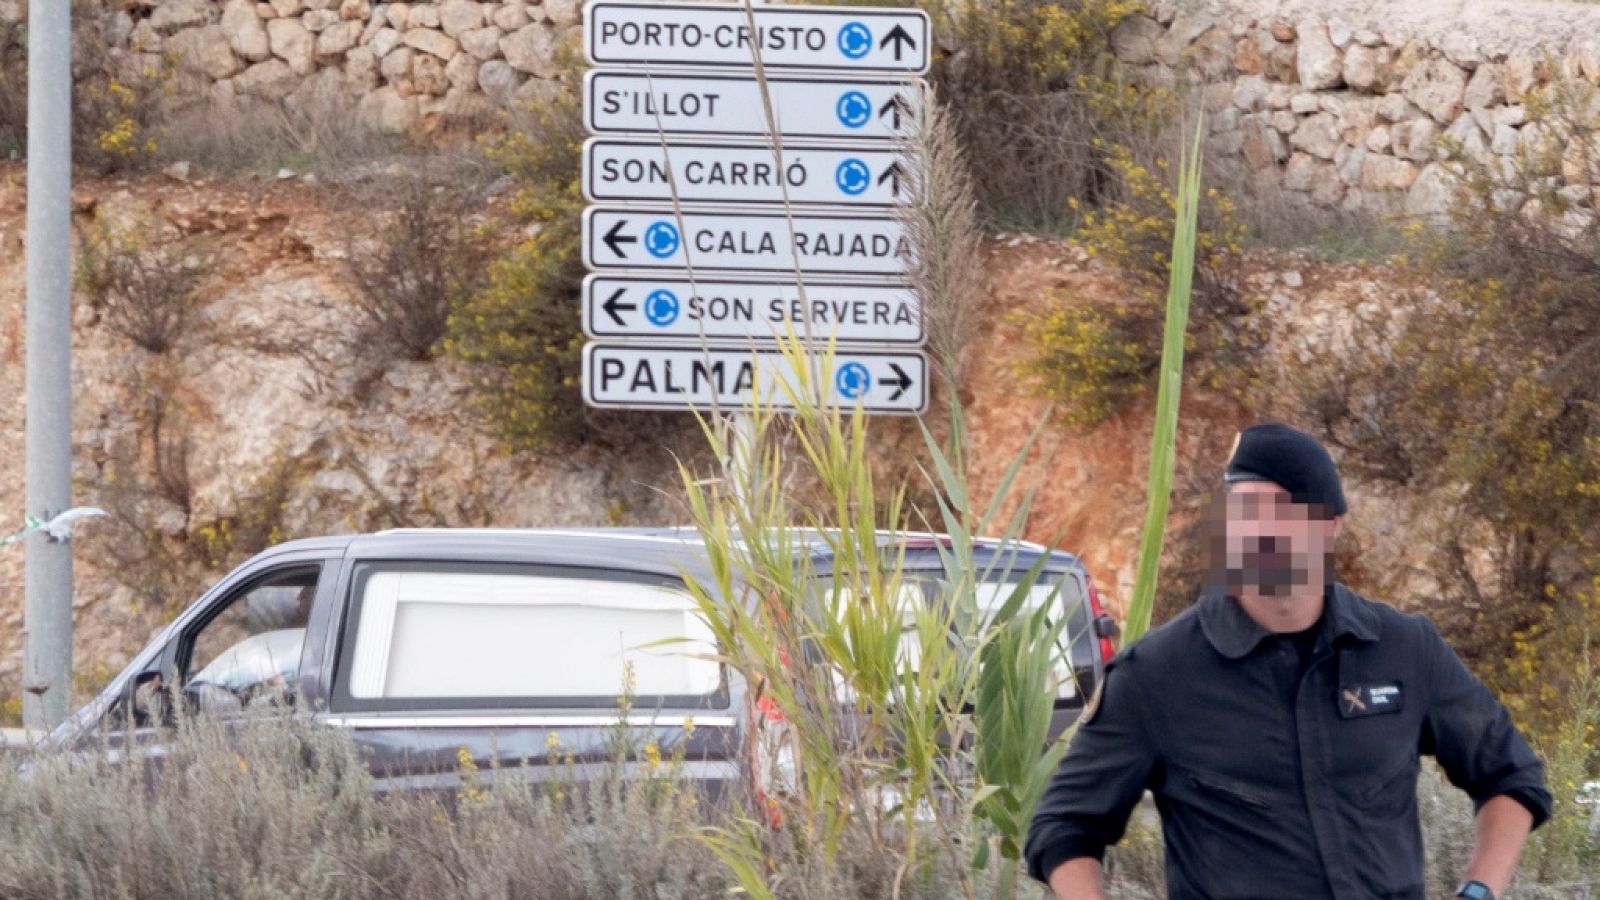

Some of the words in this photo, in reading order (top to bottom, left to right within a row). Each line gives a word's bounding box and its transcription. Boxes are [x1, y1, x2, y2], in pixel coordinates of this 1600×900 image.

[601, 21, 826, 51] PORTO-CRISTO
[602, 91, 720, 117] S'ILLOT
[602, 159, 671, 183] SON
[685, 157, 808, 187] CARRIÓ
[695, 230, 776, 255] CALA
[792, 232, 912, 258] RAJADA
[688, 297, 753, 321] SON
[770, 301, 912, 326] SERVERA
[601, 359, 759, 395] PALMA
